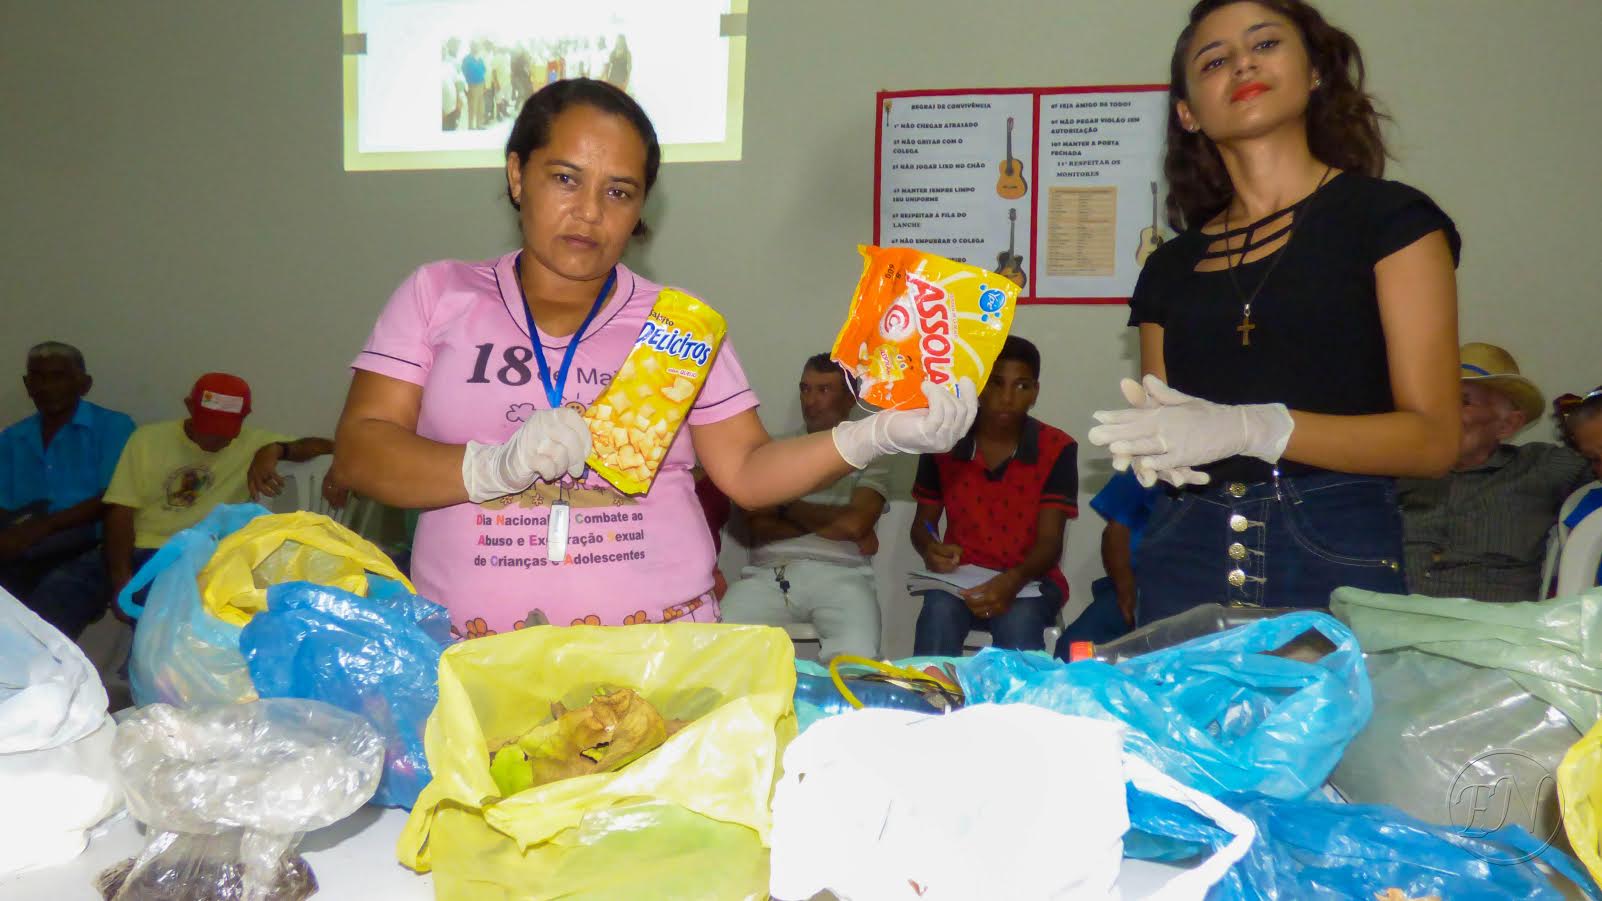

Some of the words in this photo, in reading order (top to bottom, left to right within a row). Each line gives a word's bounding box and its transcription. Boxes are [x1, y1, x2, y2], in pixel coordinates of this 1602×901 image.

[906, 274, 951, 384] ASSOLA
[466, 343, 534, 386] 18
[577, 368, 617, 386] Ma
[476, 514, 492, 526] Dia
[496, 514, 550, 526] Nacional
[575, 512, 629, 524] Combate
[632, 513, 644, 521] ao
[478, 534, 513, 546] Abuso
[529, 533, 604, 547] Exração
[608, 530, 644, 542] Sexual
[474, 555, 487, 566] de
[491, 555, 547, 569] Crianças
[564, 550, 645, 565] Adolescentes
